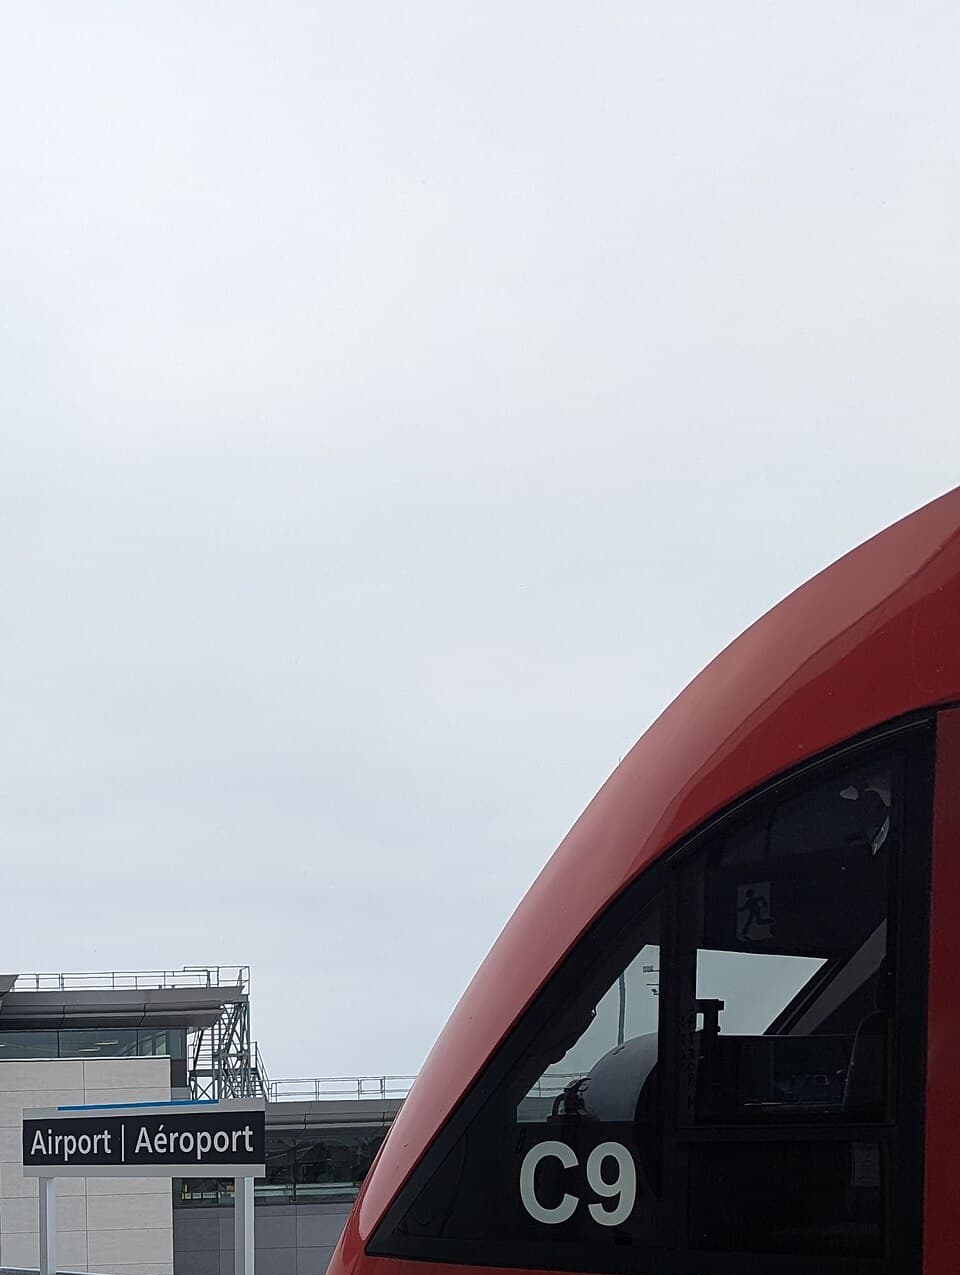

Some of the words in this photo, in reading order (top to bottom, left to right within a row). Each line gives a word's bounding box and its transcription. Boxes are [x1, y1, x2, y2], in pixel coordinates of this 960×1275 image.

[30, 1128, 112, 1162] Airport
[134, 1123, 255, 1161] Aéroport
[520, 1141, 637, 1226] C9
